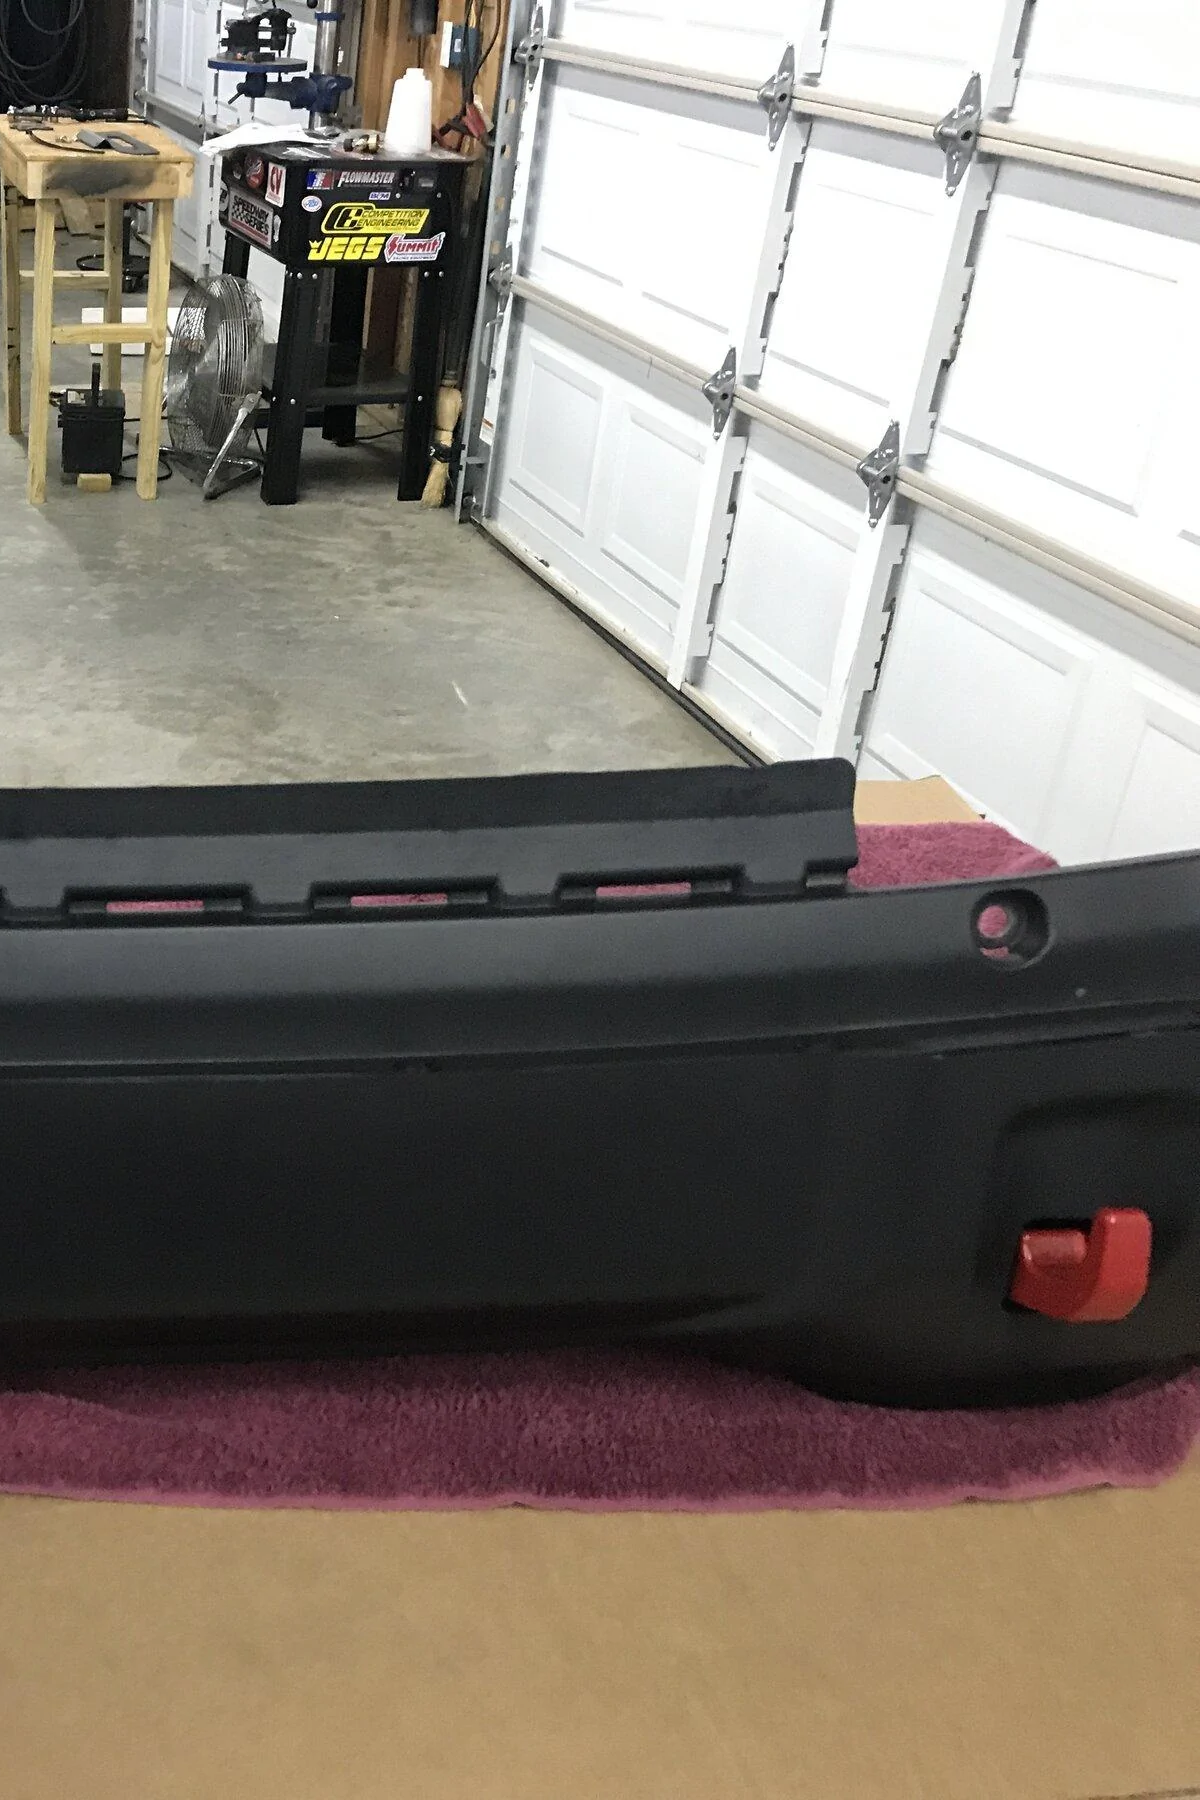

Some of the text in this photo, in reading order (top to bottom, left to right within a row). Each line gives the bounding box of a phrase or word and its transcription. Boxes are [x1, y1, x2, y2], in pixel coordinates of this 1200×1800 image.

[337, 171, 395, 187] FLOWMASTER
[234, 195, 269, 222] SPEEDWAY
[362, 209, 425, 218] COMPETITION
[244, 211, 270, 235] SERIES
[357, 218, 420, 227] ENGINEERING
[307, 236, 386, 261] JEGS
